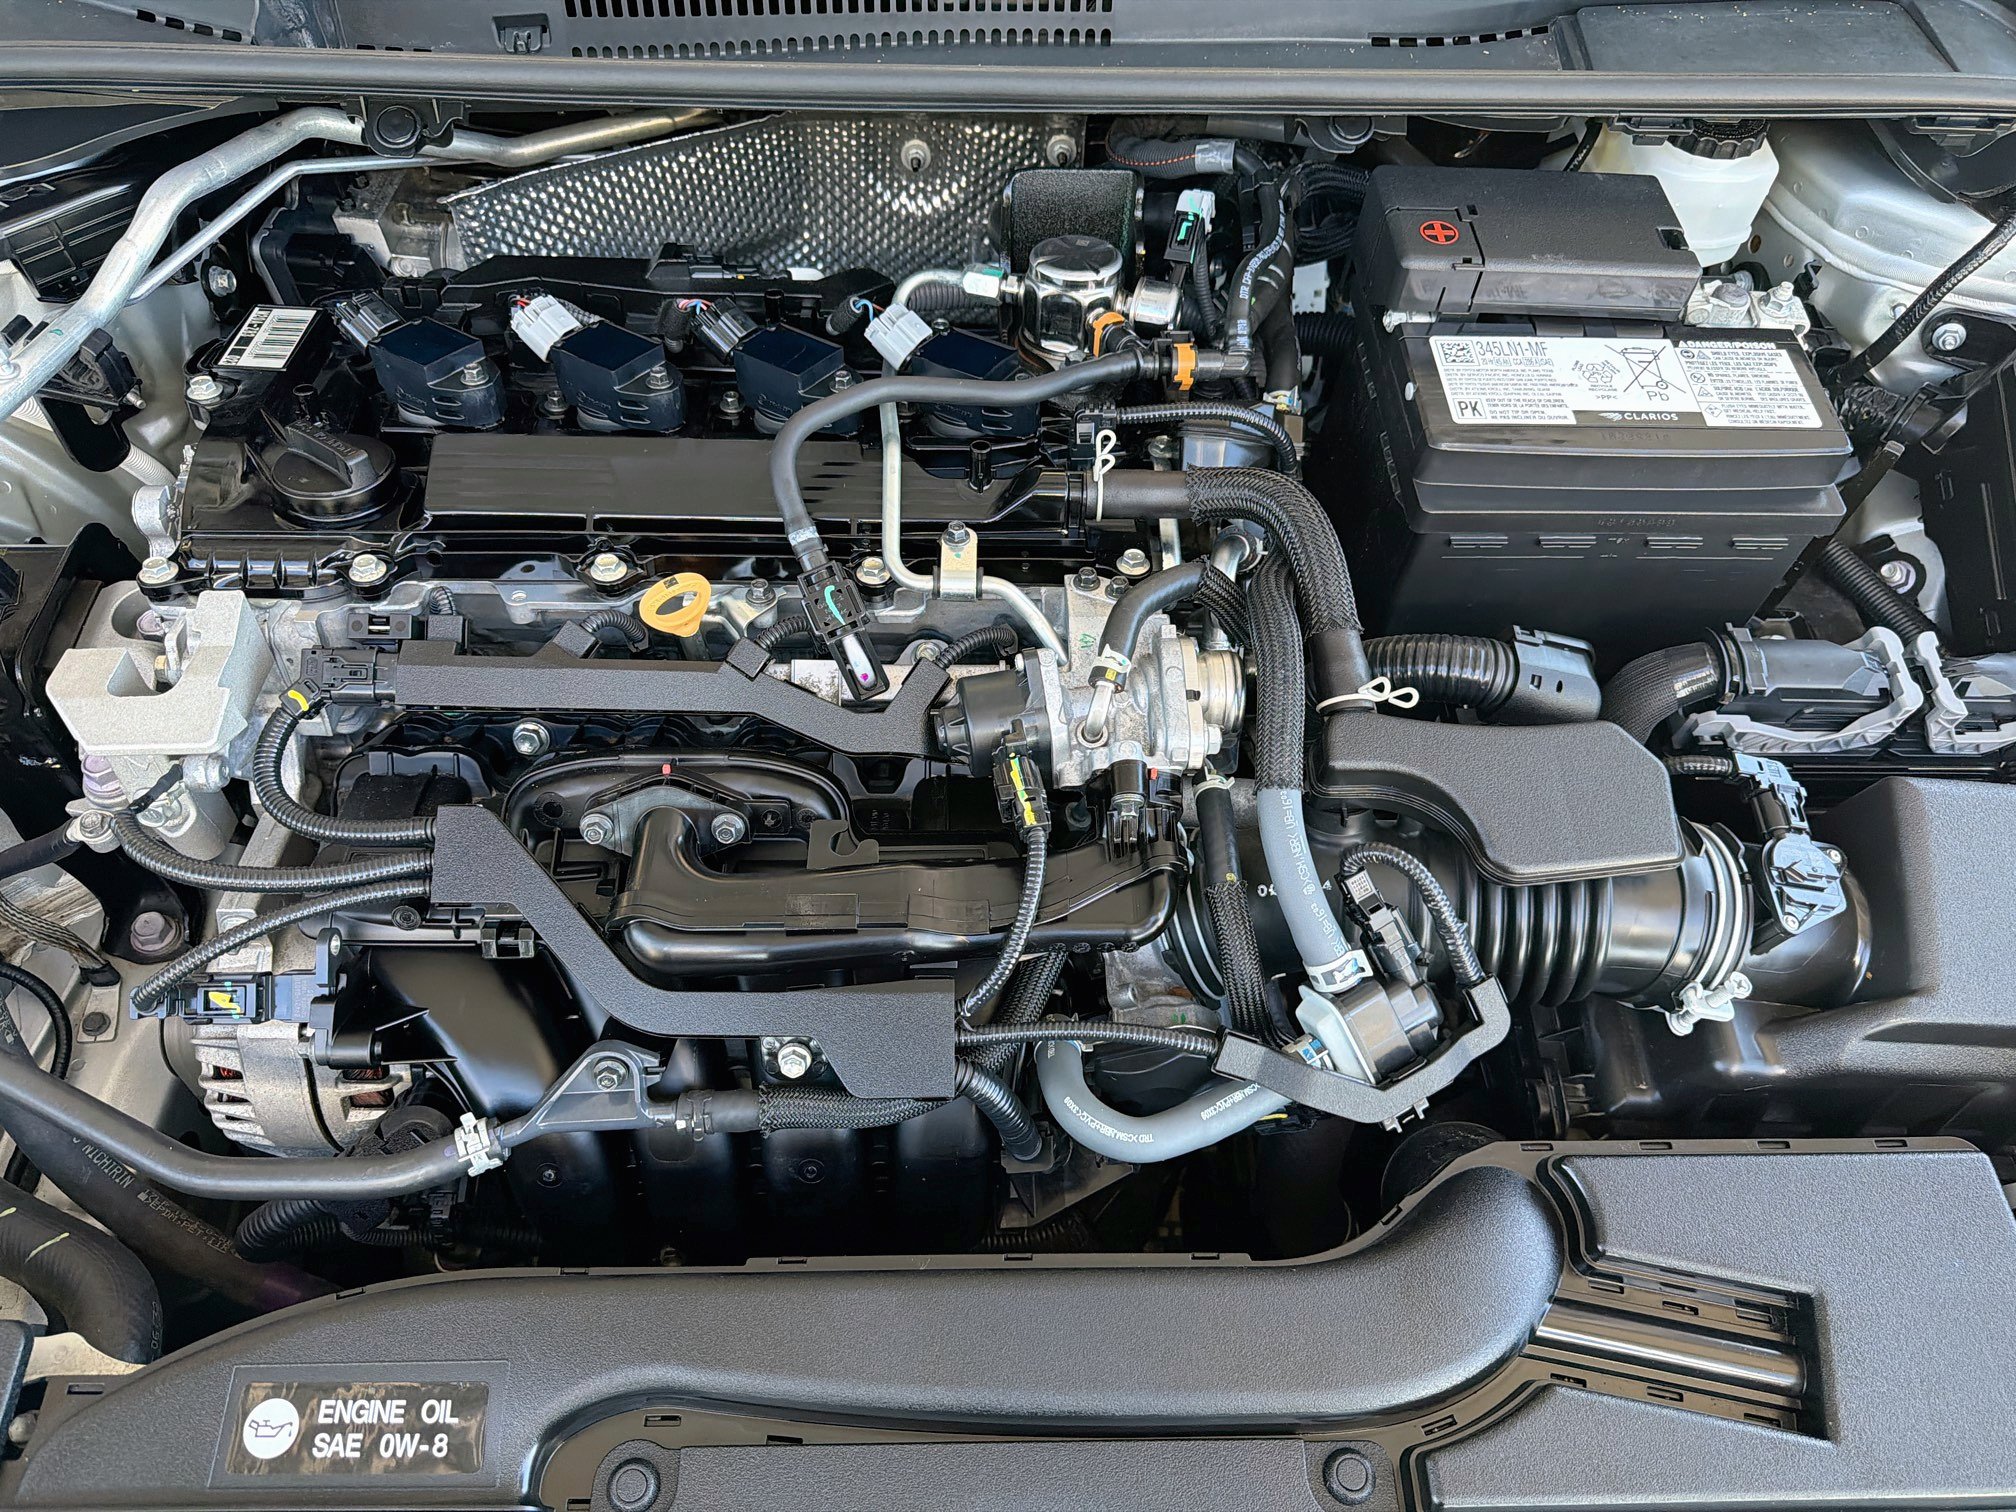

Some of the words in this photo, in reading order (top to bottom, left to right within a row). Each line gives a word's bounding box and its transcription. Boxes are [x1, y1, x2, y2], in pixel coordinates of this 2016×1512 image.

[1475, 341, 1548, 357] 345LN1-MF
[1687, 340, 1777, 350] DANGER/POISON
[1646, 390, 1670, 401] Pb
[1457, 400, 1483, 417] PK
[1624, 412, 1679, 421] CLARIOS
[82, 1144, 135, 1188] NICHIRIN
[317, 1399, 406, 1424] ENGINE
[421, 1399, 459, 1424] OIL
[312, 1432, 361, 1458] SAE
[379, 1432, 449, 1458] 0W-8
